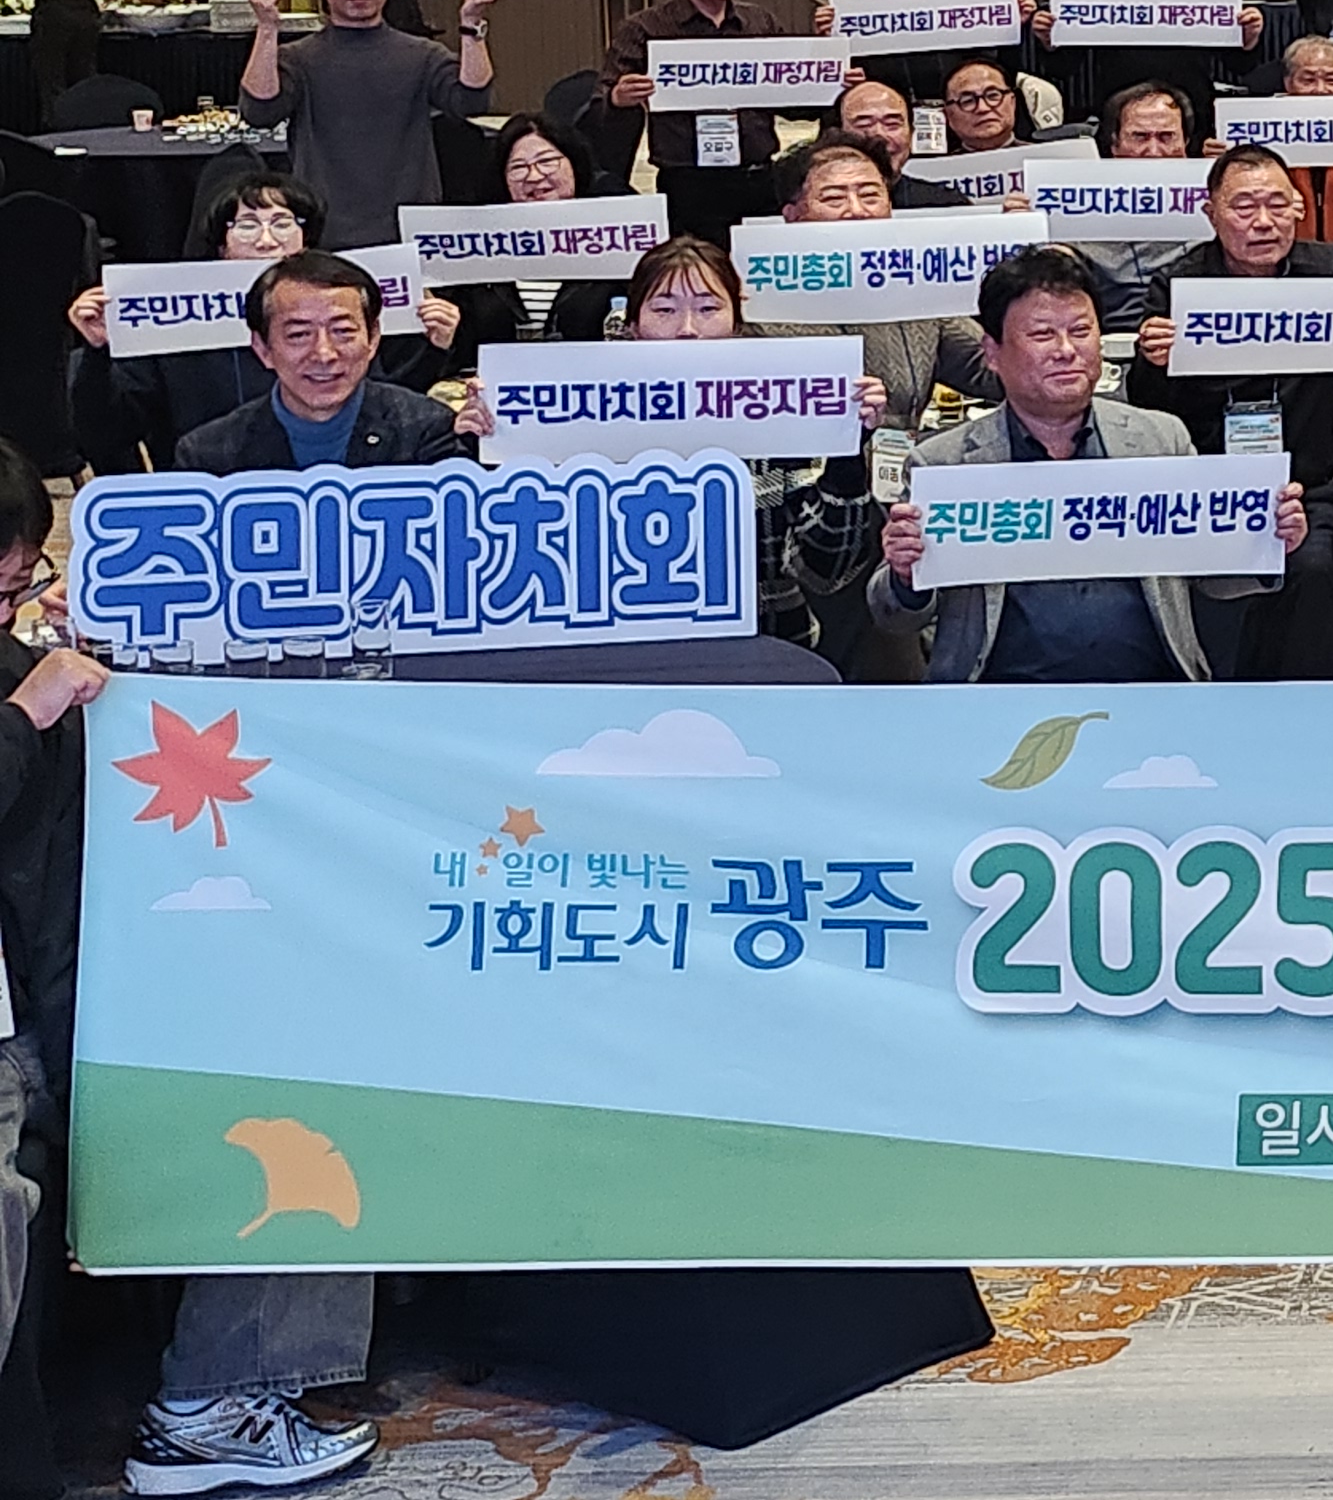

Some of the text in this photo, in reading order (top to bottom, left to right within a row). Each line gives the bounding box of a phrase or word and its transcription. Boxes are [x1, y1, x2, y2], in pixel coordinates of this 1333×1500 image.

[839, 2, 1012, 37] 주민자치회 재정자립
[1059, 3, 1235, 27] 주민자치회 재정자립
[656, 59, 842, 88] 주민자치회 재정자립
[1035, 186, 1164, 216] 주민자치회
[413, 223, 658, 259] 주민자치회 재정자립
[746, 251, 853, 291] 주민총회
[860, 246, 978, 288] 정책·예산
[118, 288, 247, 328] 주민자치
[1184, 311, 1332, 345] 주민자치회
[497, 377, 848, 426] 주민자치회 재정자립
[924, 489, 1270, 544] 주민총회 정책·예산 반영
[94, 474, 742, 638] 주민자치회
[433, 852, 467, 889] 내
[586, 852, 690, 890] 빛나는
[423, 856, 929, 971] 기회도시 광주
